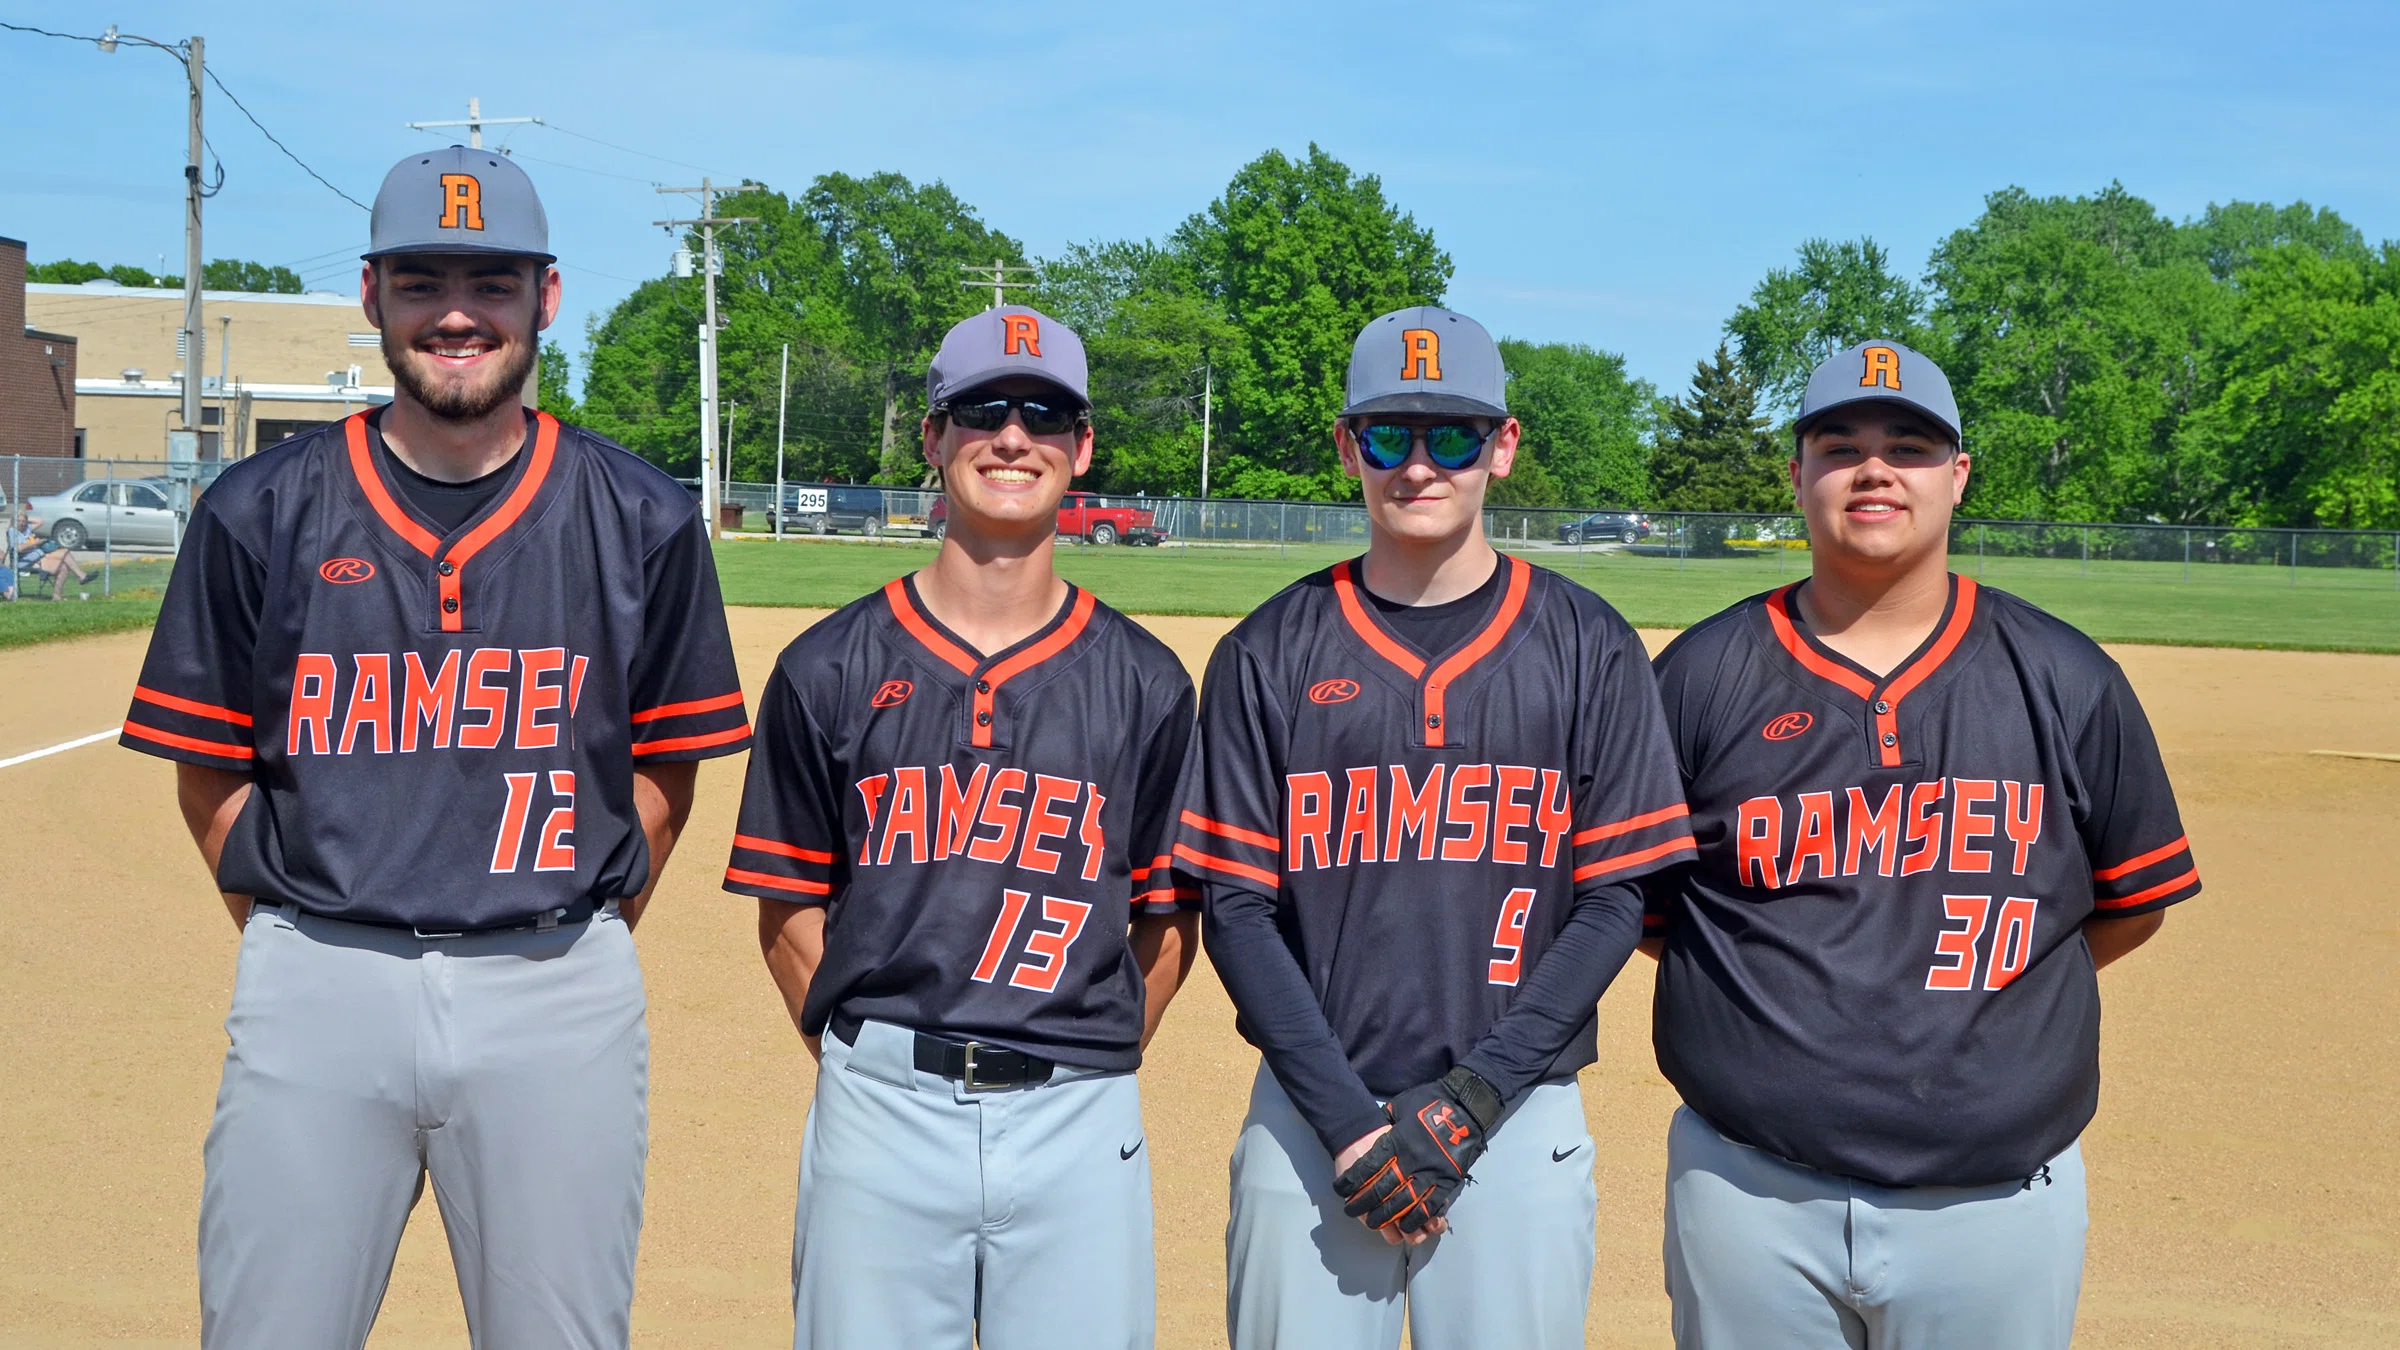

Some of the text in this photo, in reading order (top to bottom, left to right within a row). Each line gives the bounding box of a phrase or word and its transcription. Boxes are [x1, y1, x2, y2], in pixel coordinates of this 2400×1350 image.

[438, 173, 485, 231] R
[1001, 314, 1042, 358] R
[1400, 328, 1442, 381] R
[1859, 346, 1902, 391] R
[800, 494, 826, 508] 295
[489, 770, 575, 873] 12
[1286, 763, 1572, 871] RAMSEY
[1737, 777, 2044, 889] RAMSEY
[970, 888, 1093, 993] 13
[1488, 887, 1537, 987] 9
[1924, 894, 2039, 991] 30
